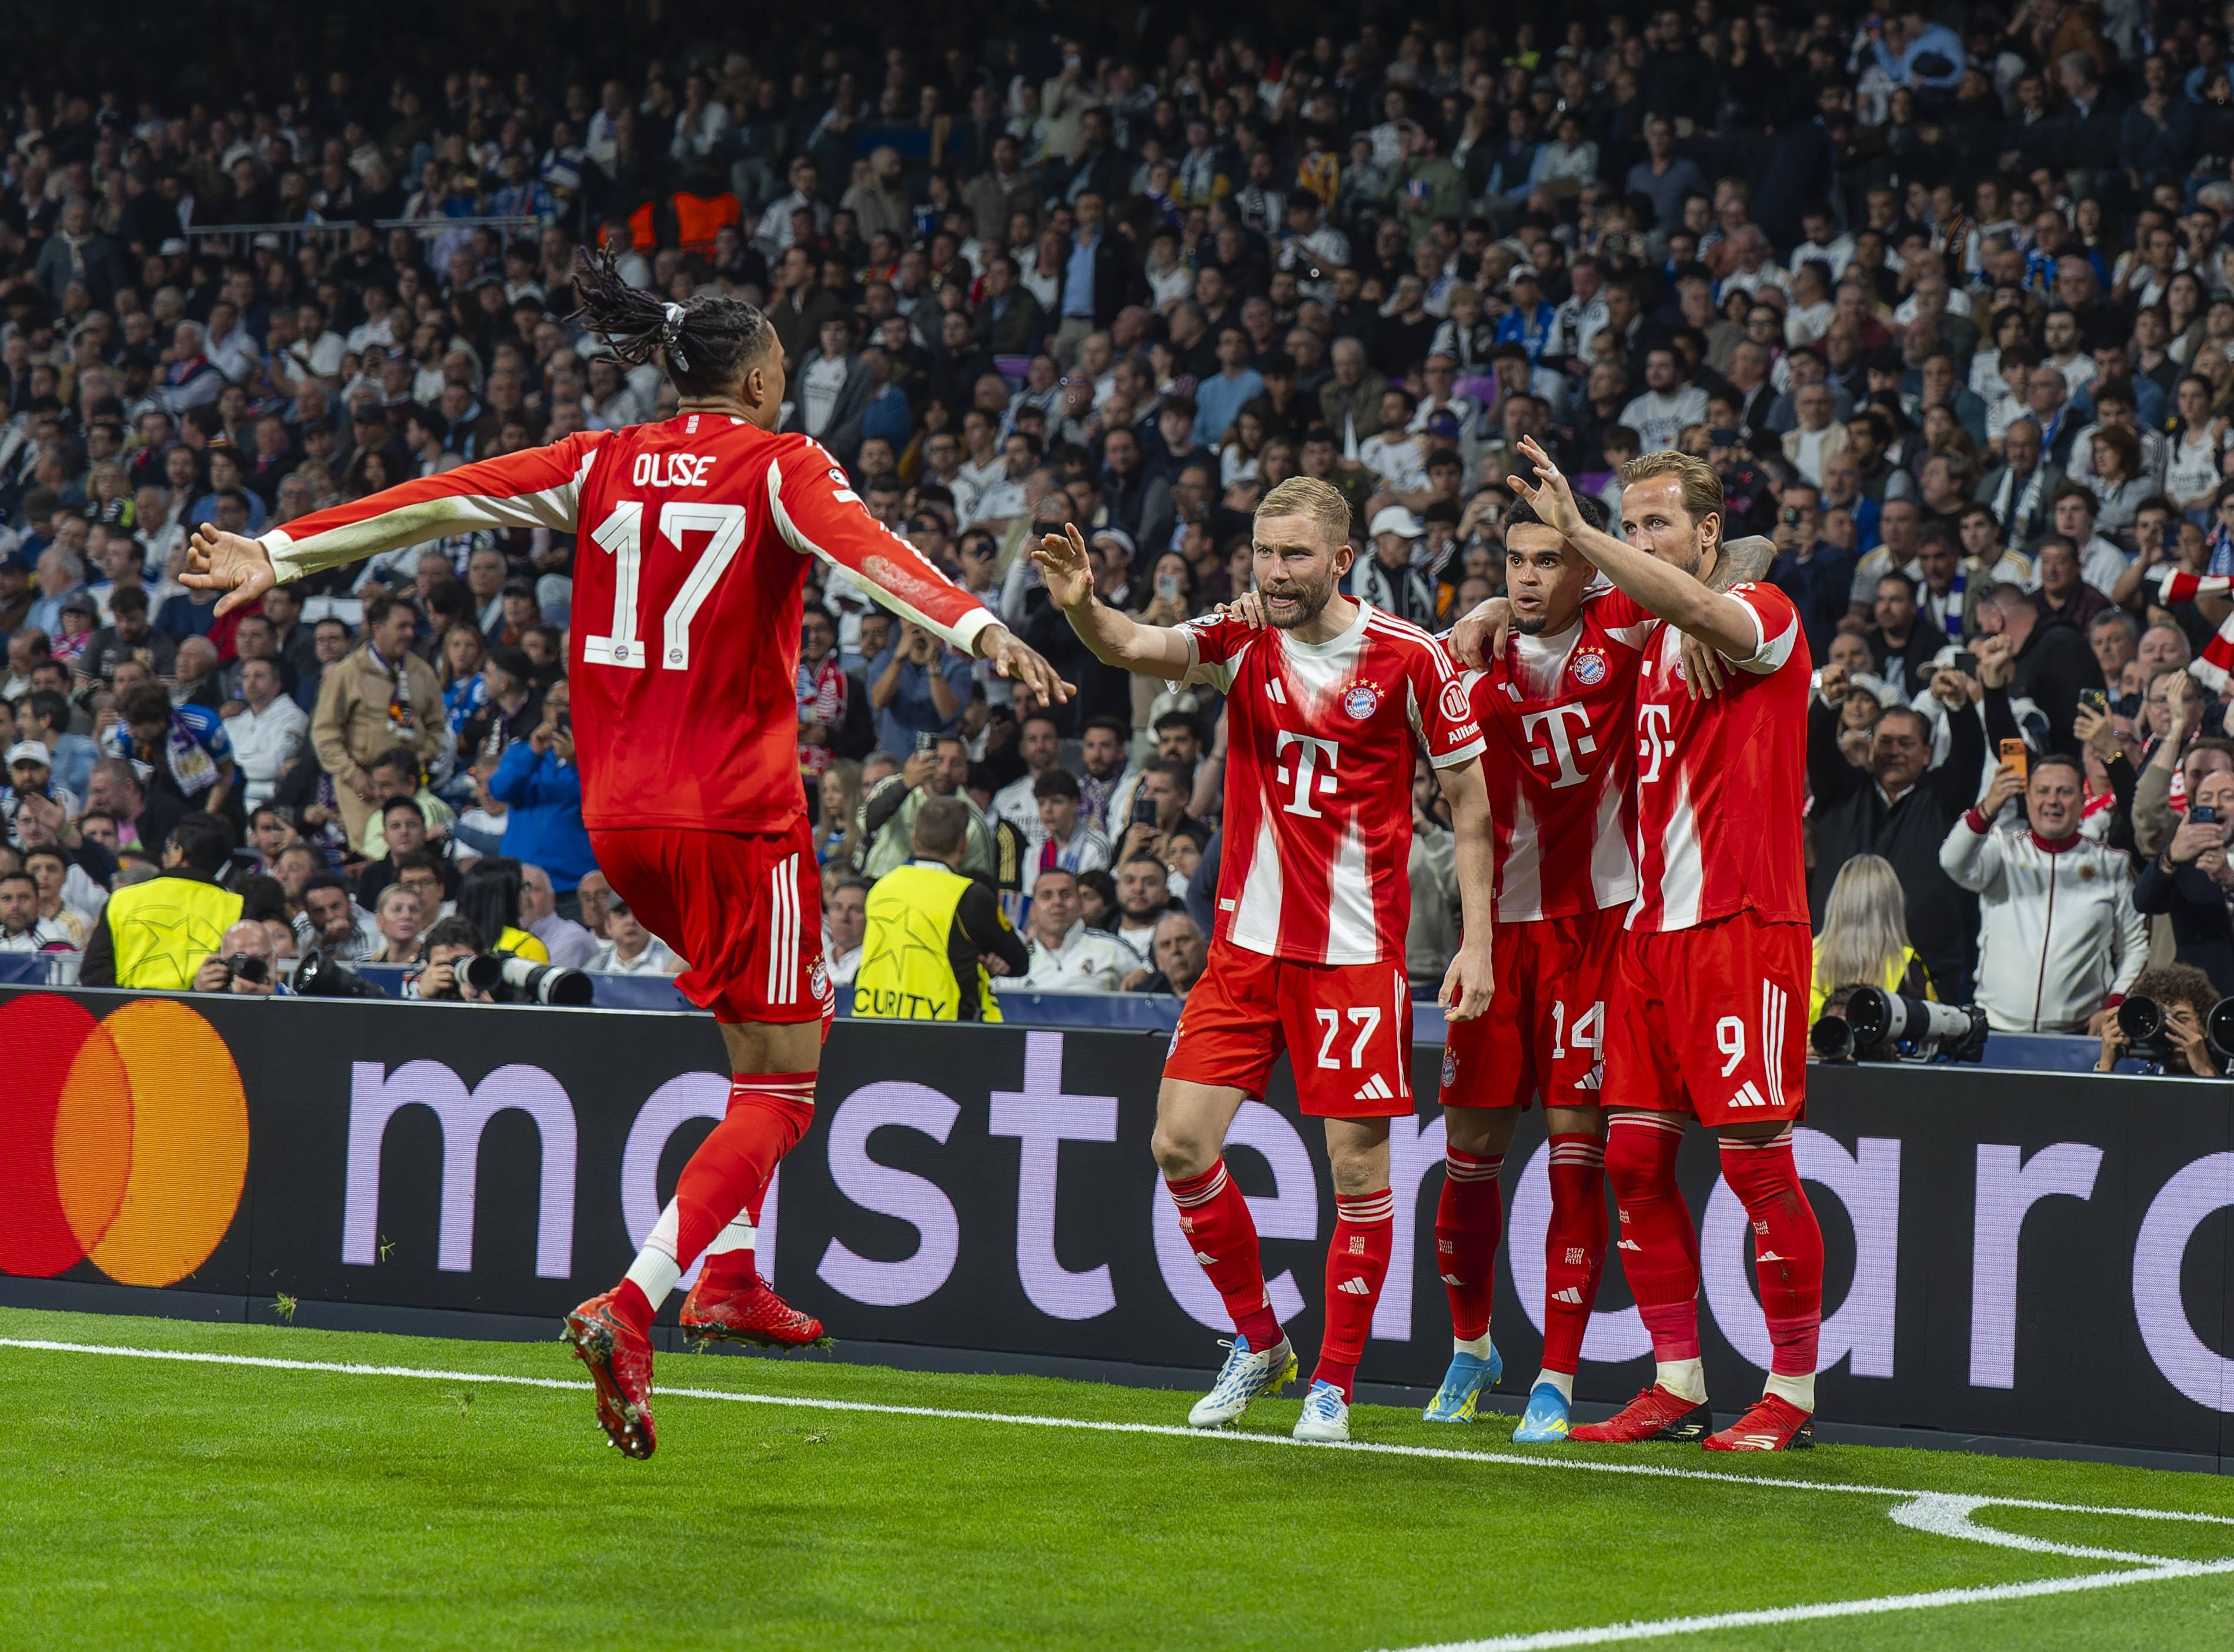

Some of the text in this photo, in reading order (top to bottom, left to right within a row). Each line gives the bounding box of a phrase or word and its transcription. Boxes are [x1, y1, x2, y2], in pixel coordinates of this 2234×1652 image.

[633, 453, 717, 487] OLISE
[583, 500, 746, 670] 17
[1448, 720, 1480, 745] Allian
[1315, 1006, 1381, 1070] 27
[1552, 1000, 1605, 1060] 14
[1716, 1016, 1745, 1077] 9
